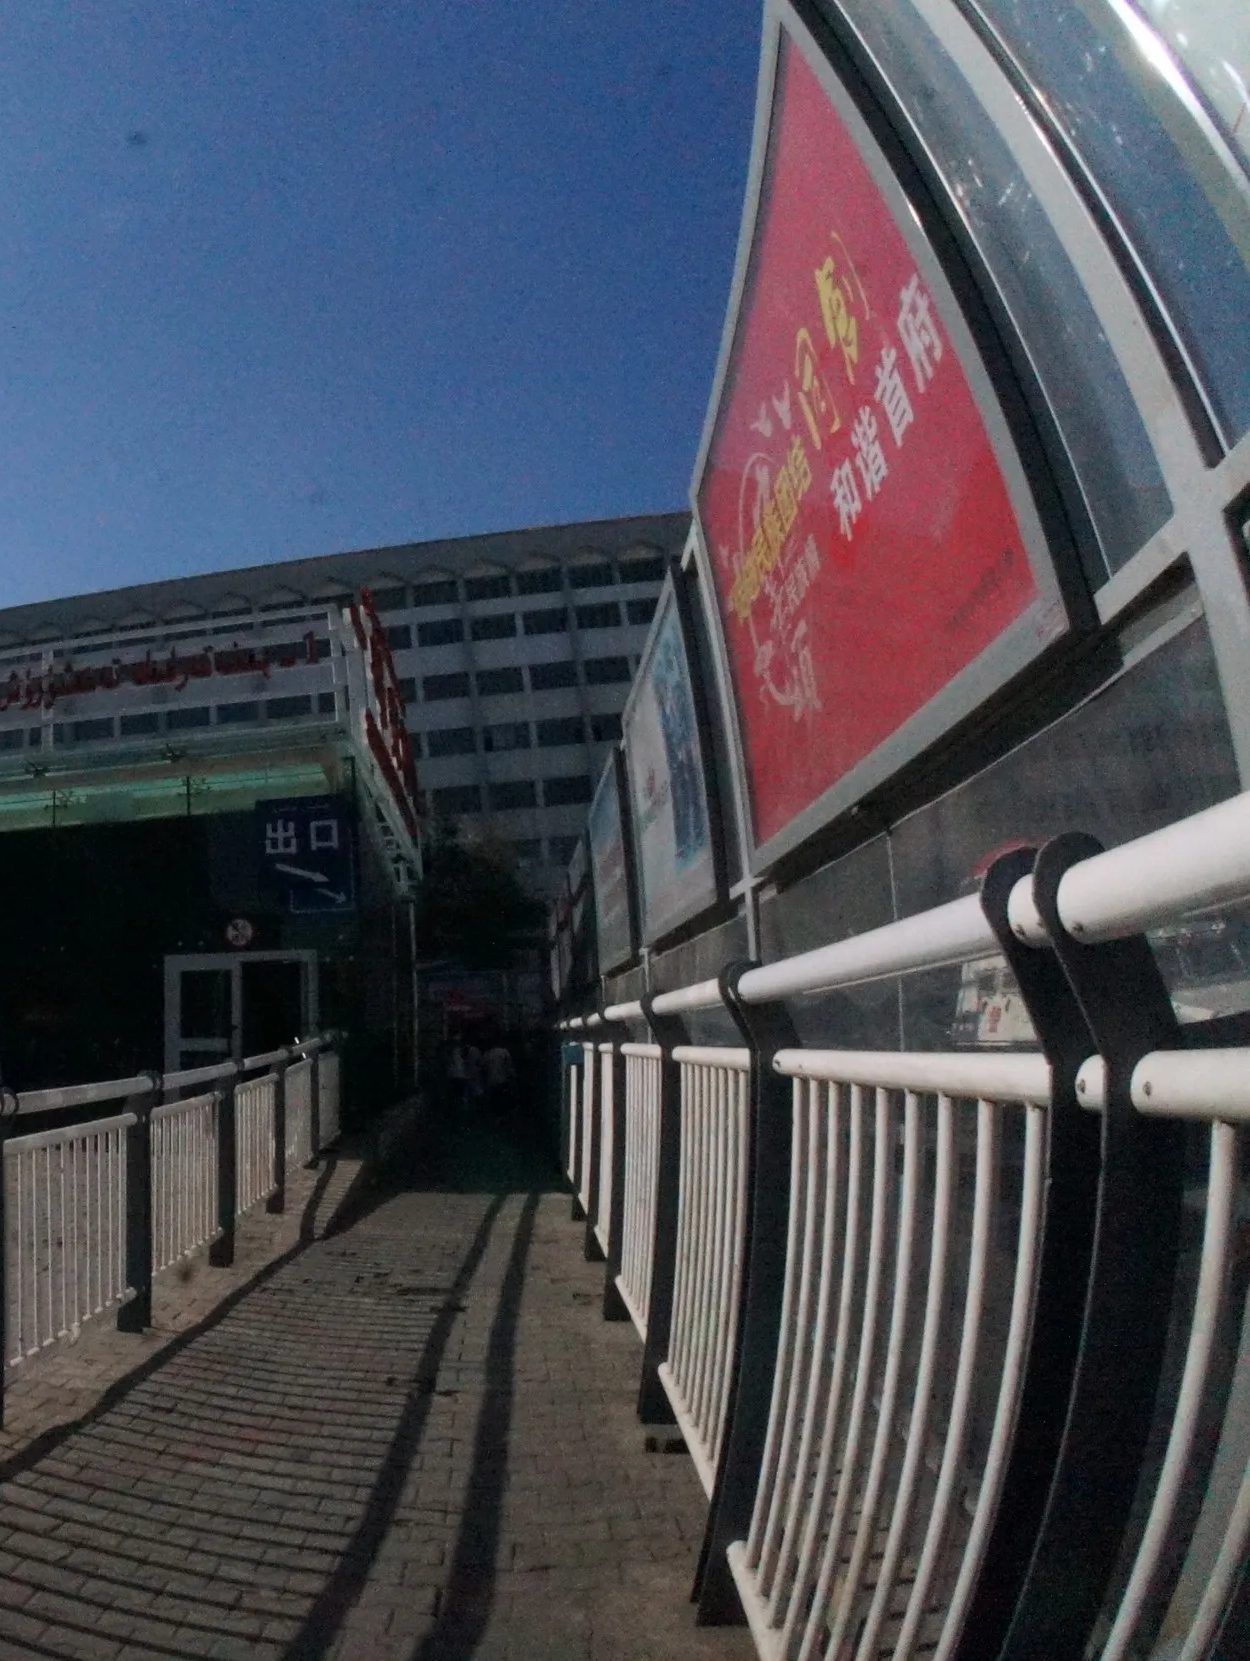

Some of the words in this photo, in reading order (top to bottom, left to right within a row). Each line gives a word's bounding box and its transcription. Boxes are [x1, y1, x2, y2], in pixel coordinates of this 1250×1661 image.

[829, 272, 945, 542] 和谐首府
[265, 818, 339, 856] 出口
